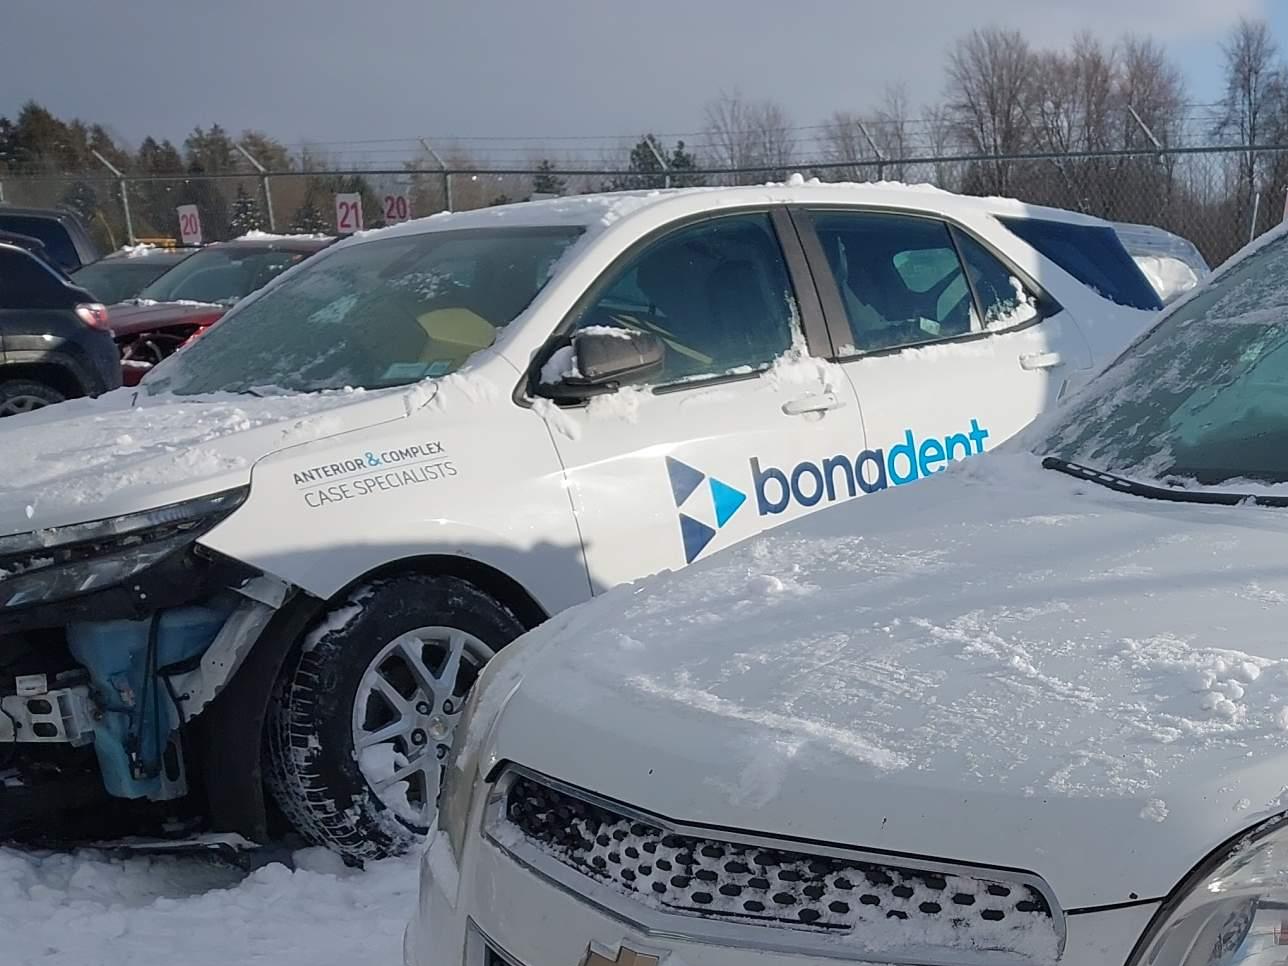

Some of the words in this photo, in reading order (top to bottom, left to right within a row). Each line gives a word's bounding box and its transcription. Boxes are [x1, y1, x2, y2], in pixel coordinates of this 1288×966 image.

[338, 201, 361, 229] 21
[384, 195, 408, 219] 20
[180, 213, 199, 236] 20
[749, 419, 989, 516] bonadent
[304, 484, 355, 508] CASE
[352, 461, 458, 496] SPECIALISTS
